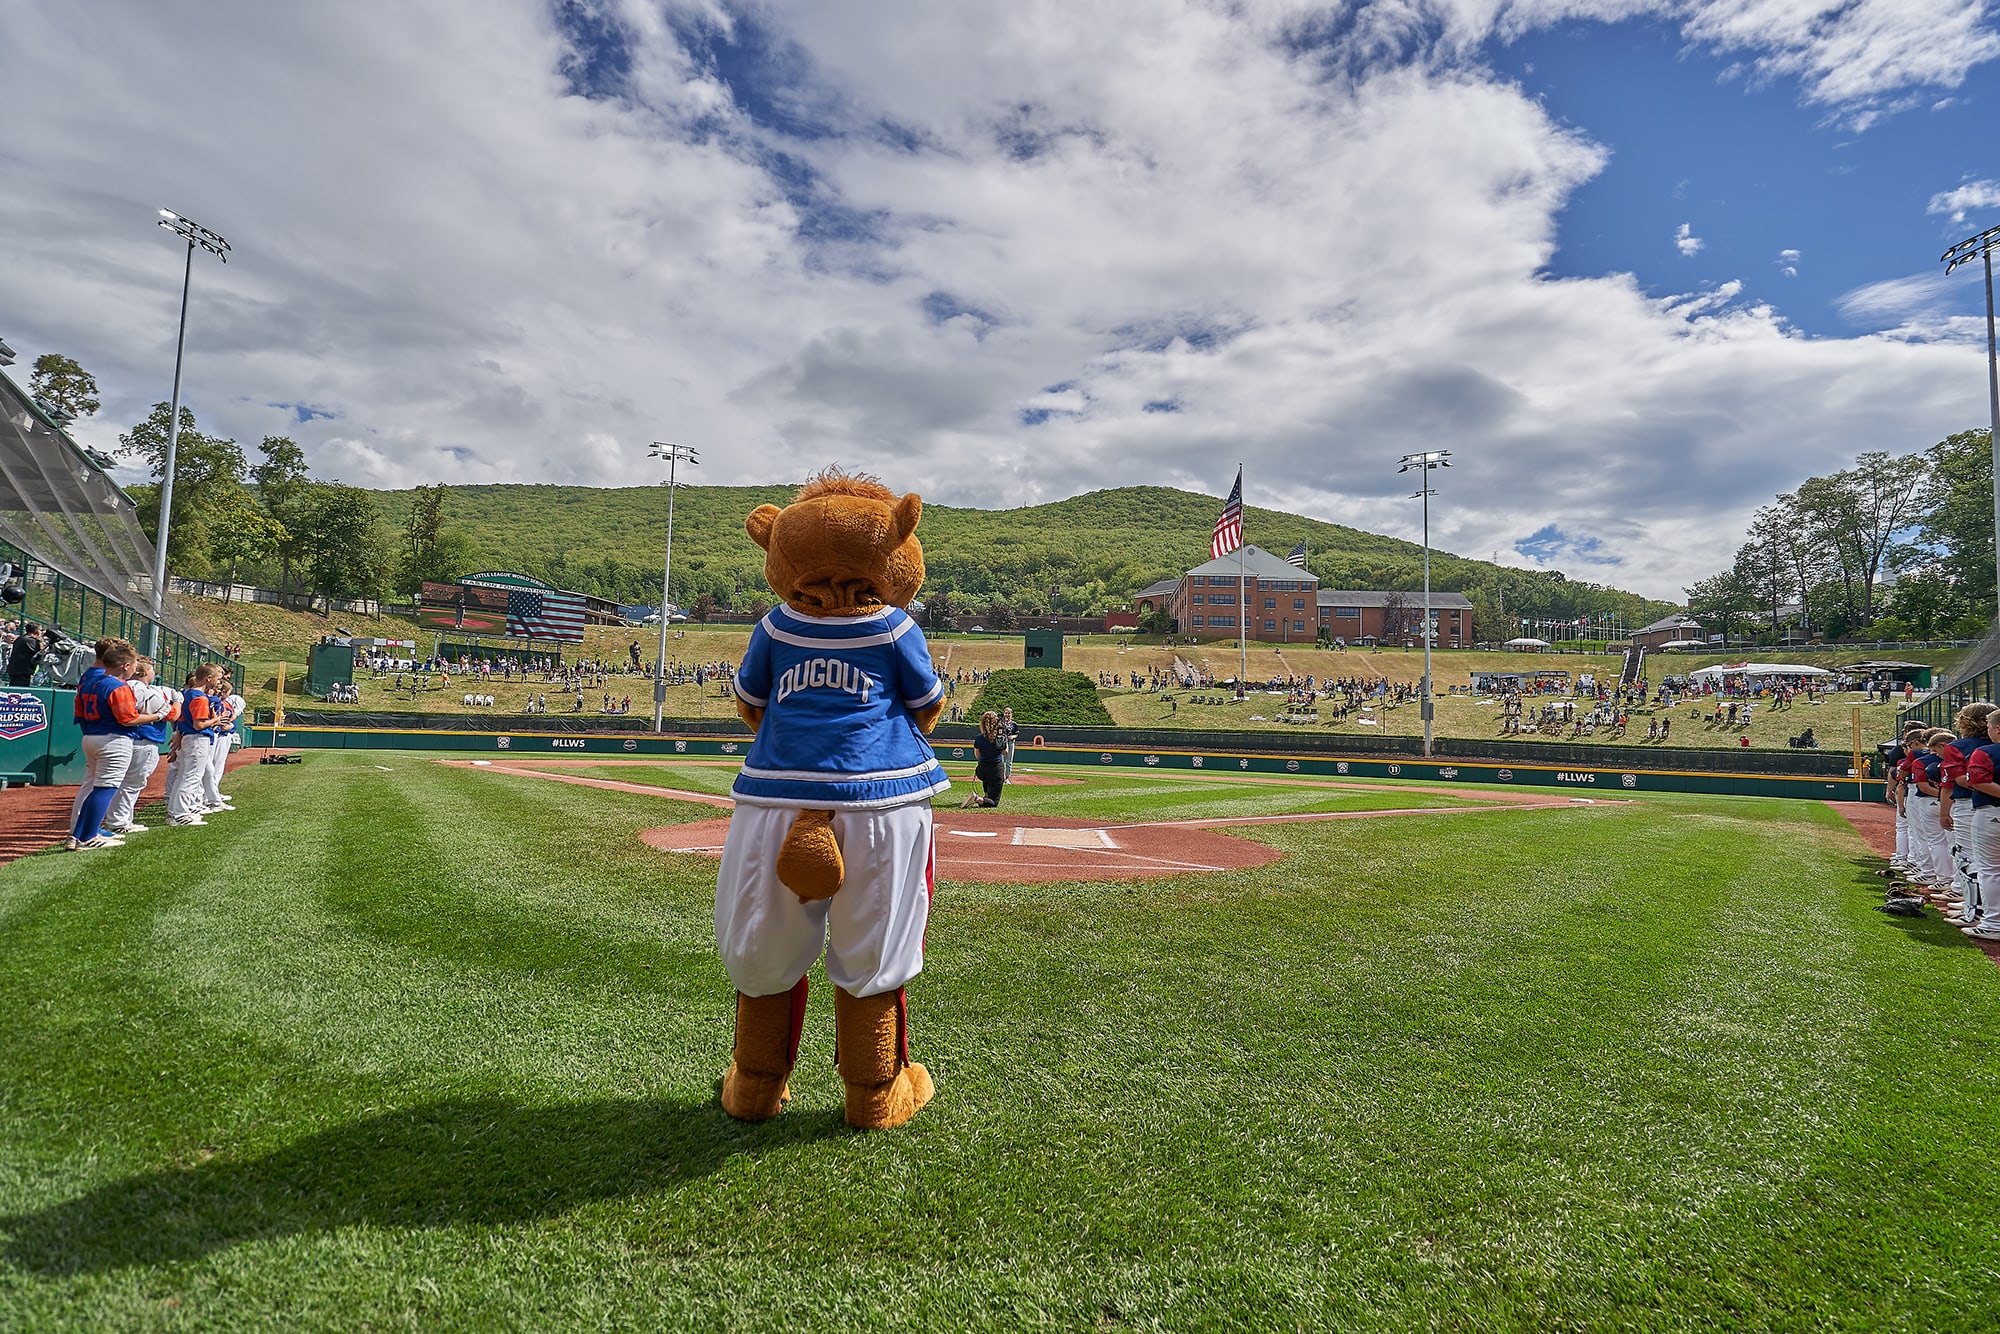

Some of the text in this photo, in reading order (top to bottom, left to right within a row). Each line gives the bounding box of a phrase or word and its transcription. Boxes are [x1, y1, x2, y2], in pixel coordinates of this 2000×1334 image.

[512, 574, 530, 582] WORLD
[530, 579, 546, 588] SERIES
[777, 658, 874, 704] DUGOUT
[14, 712, 42, 723] SERIES
[552, 739, 585, 748] #LLWS
[1556, 772, 1595, 782] #LLWS
